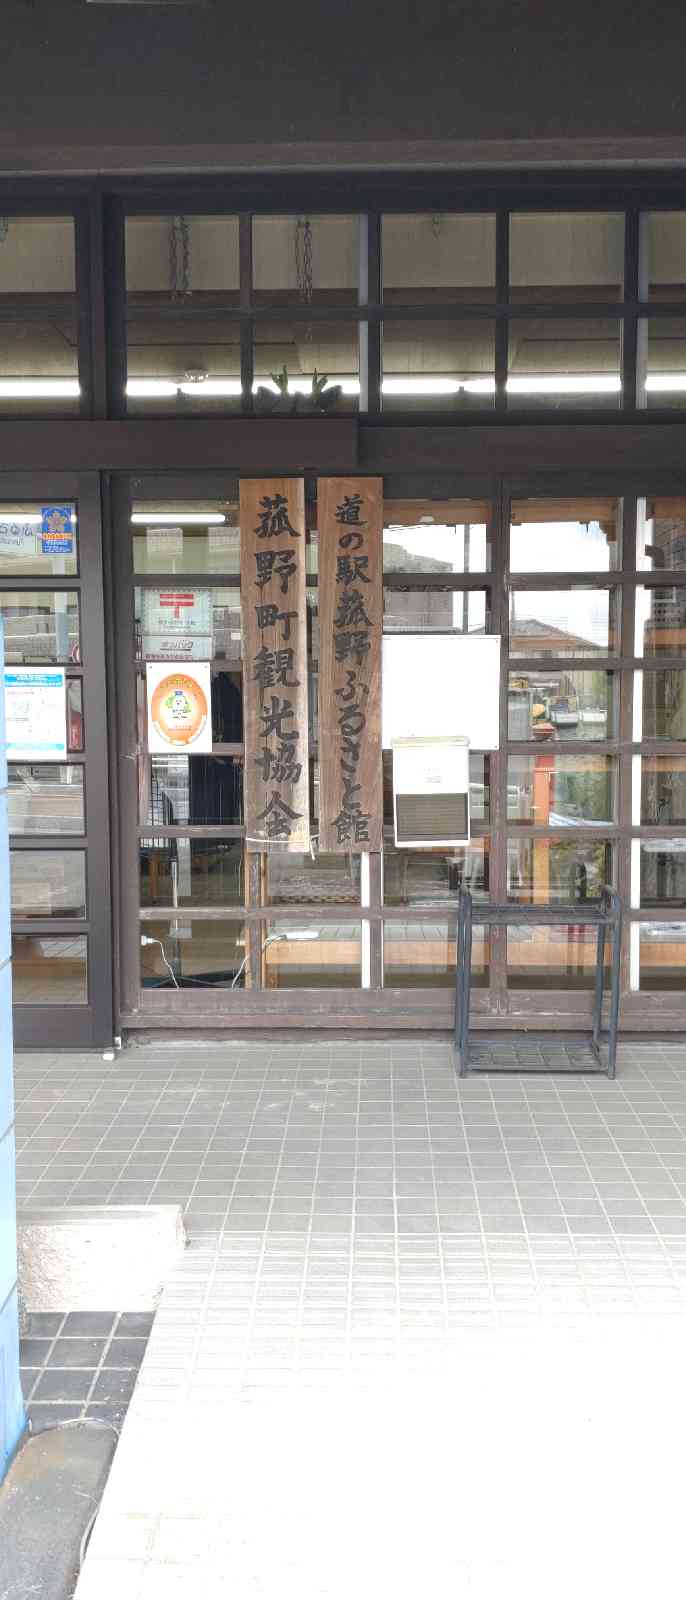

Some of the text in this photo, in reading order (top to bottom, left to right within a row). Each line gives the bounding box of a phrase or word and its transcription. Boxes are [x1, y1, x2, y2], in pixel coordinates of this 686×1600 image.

[253, 493, 303, 838] 菰野町観光協会
[331, 495, 374, 844] 道の駅菰野ふるさと館
